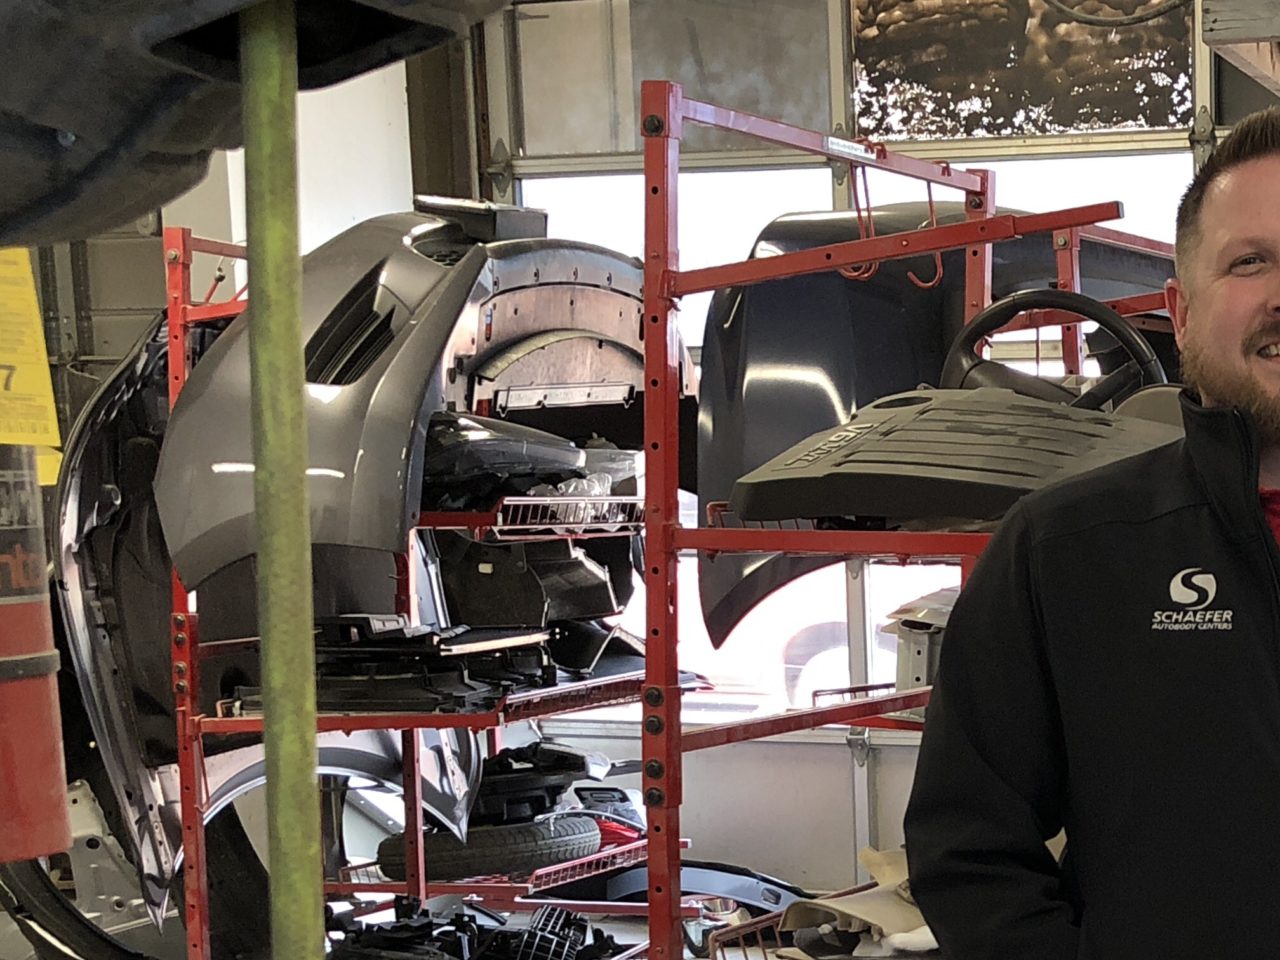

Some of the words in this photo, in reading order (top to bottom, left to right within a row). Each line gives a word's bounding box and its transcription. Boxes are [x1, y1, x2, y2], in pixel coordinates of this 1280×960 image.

[1152, 610, 1233, 622] SCHAEFER
[1152, 622, 1197, 630] AUTOBODY
[1198, 622, 1232, 630] CENTERS
